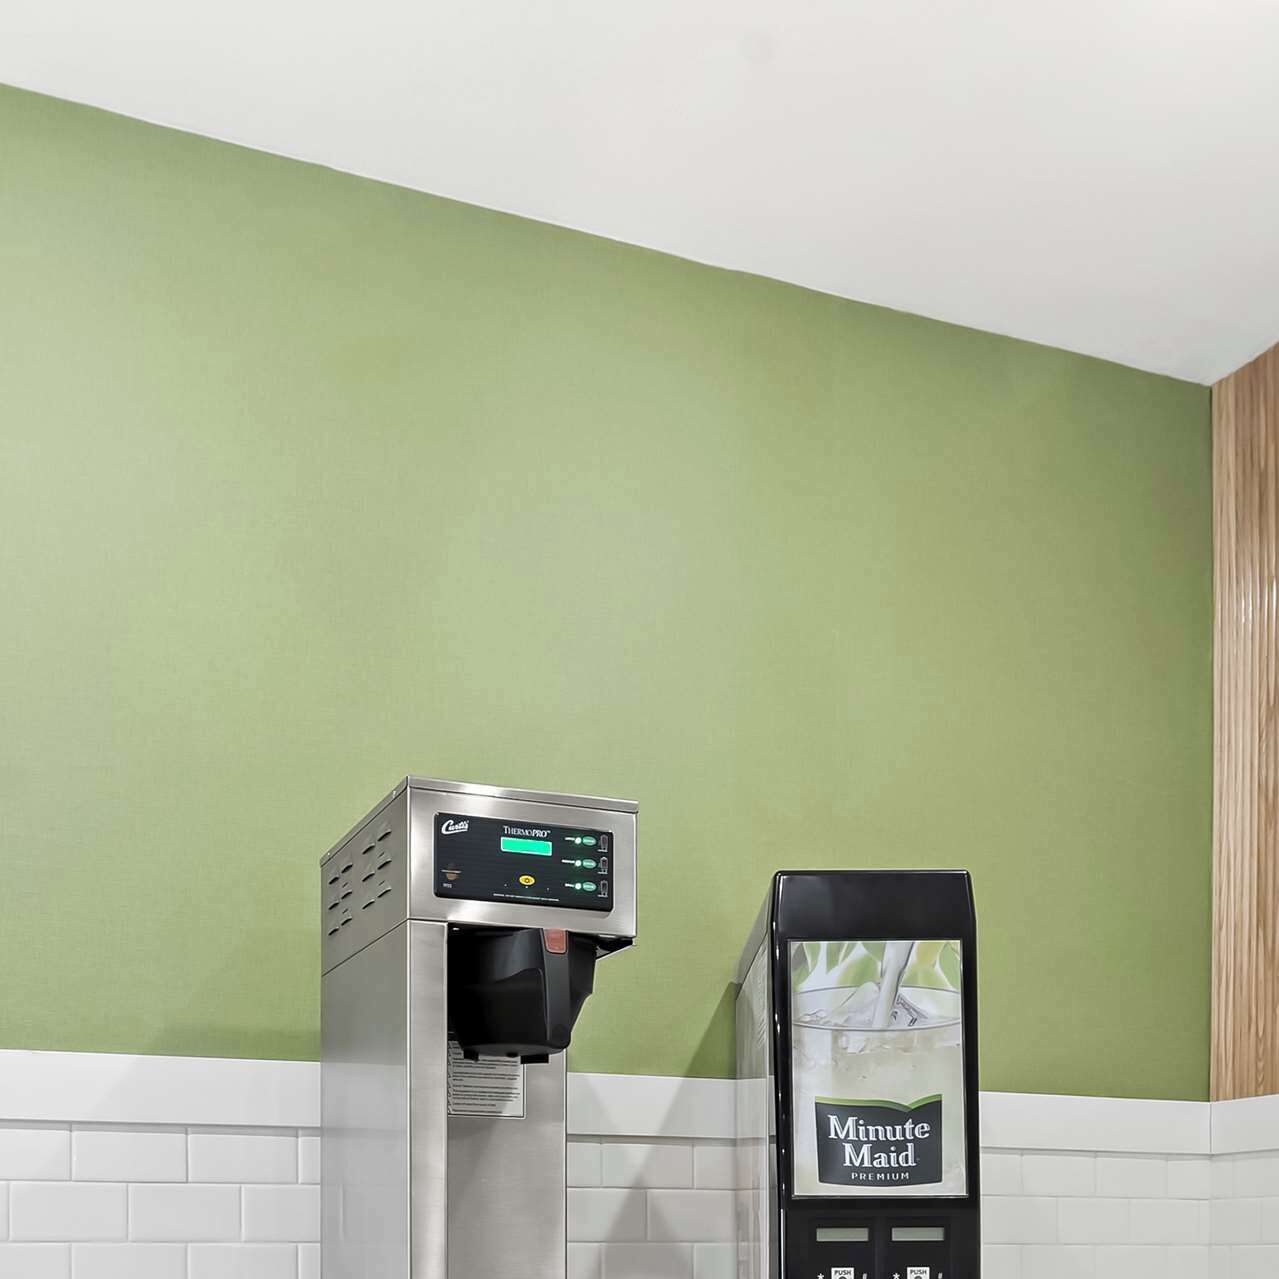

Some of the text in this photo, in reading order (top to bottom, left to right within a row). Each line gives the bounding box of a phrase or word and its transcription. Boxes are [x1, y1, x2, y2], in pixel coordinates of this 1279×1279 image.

[827, 1114, 931, 1141] Minute
[842, 1142, 917, 1168] Maid
[851, 1172, 910, 1180] PREMIUM
